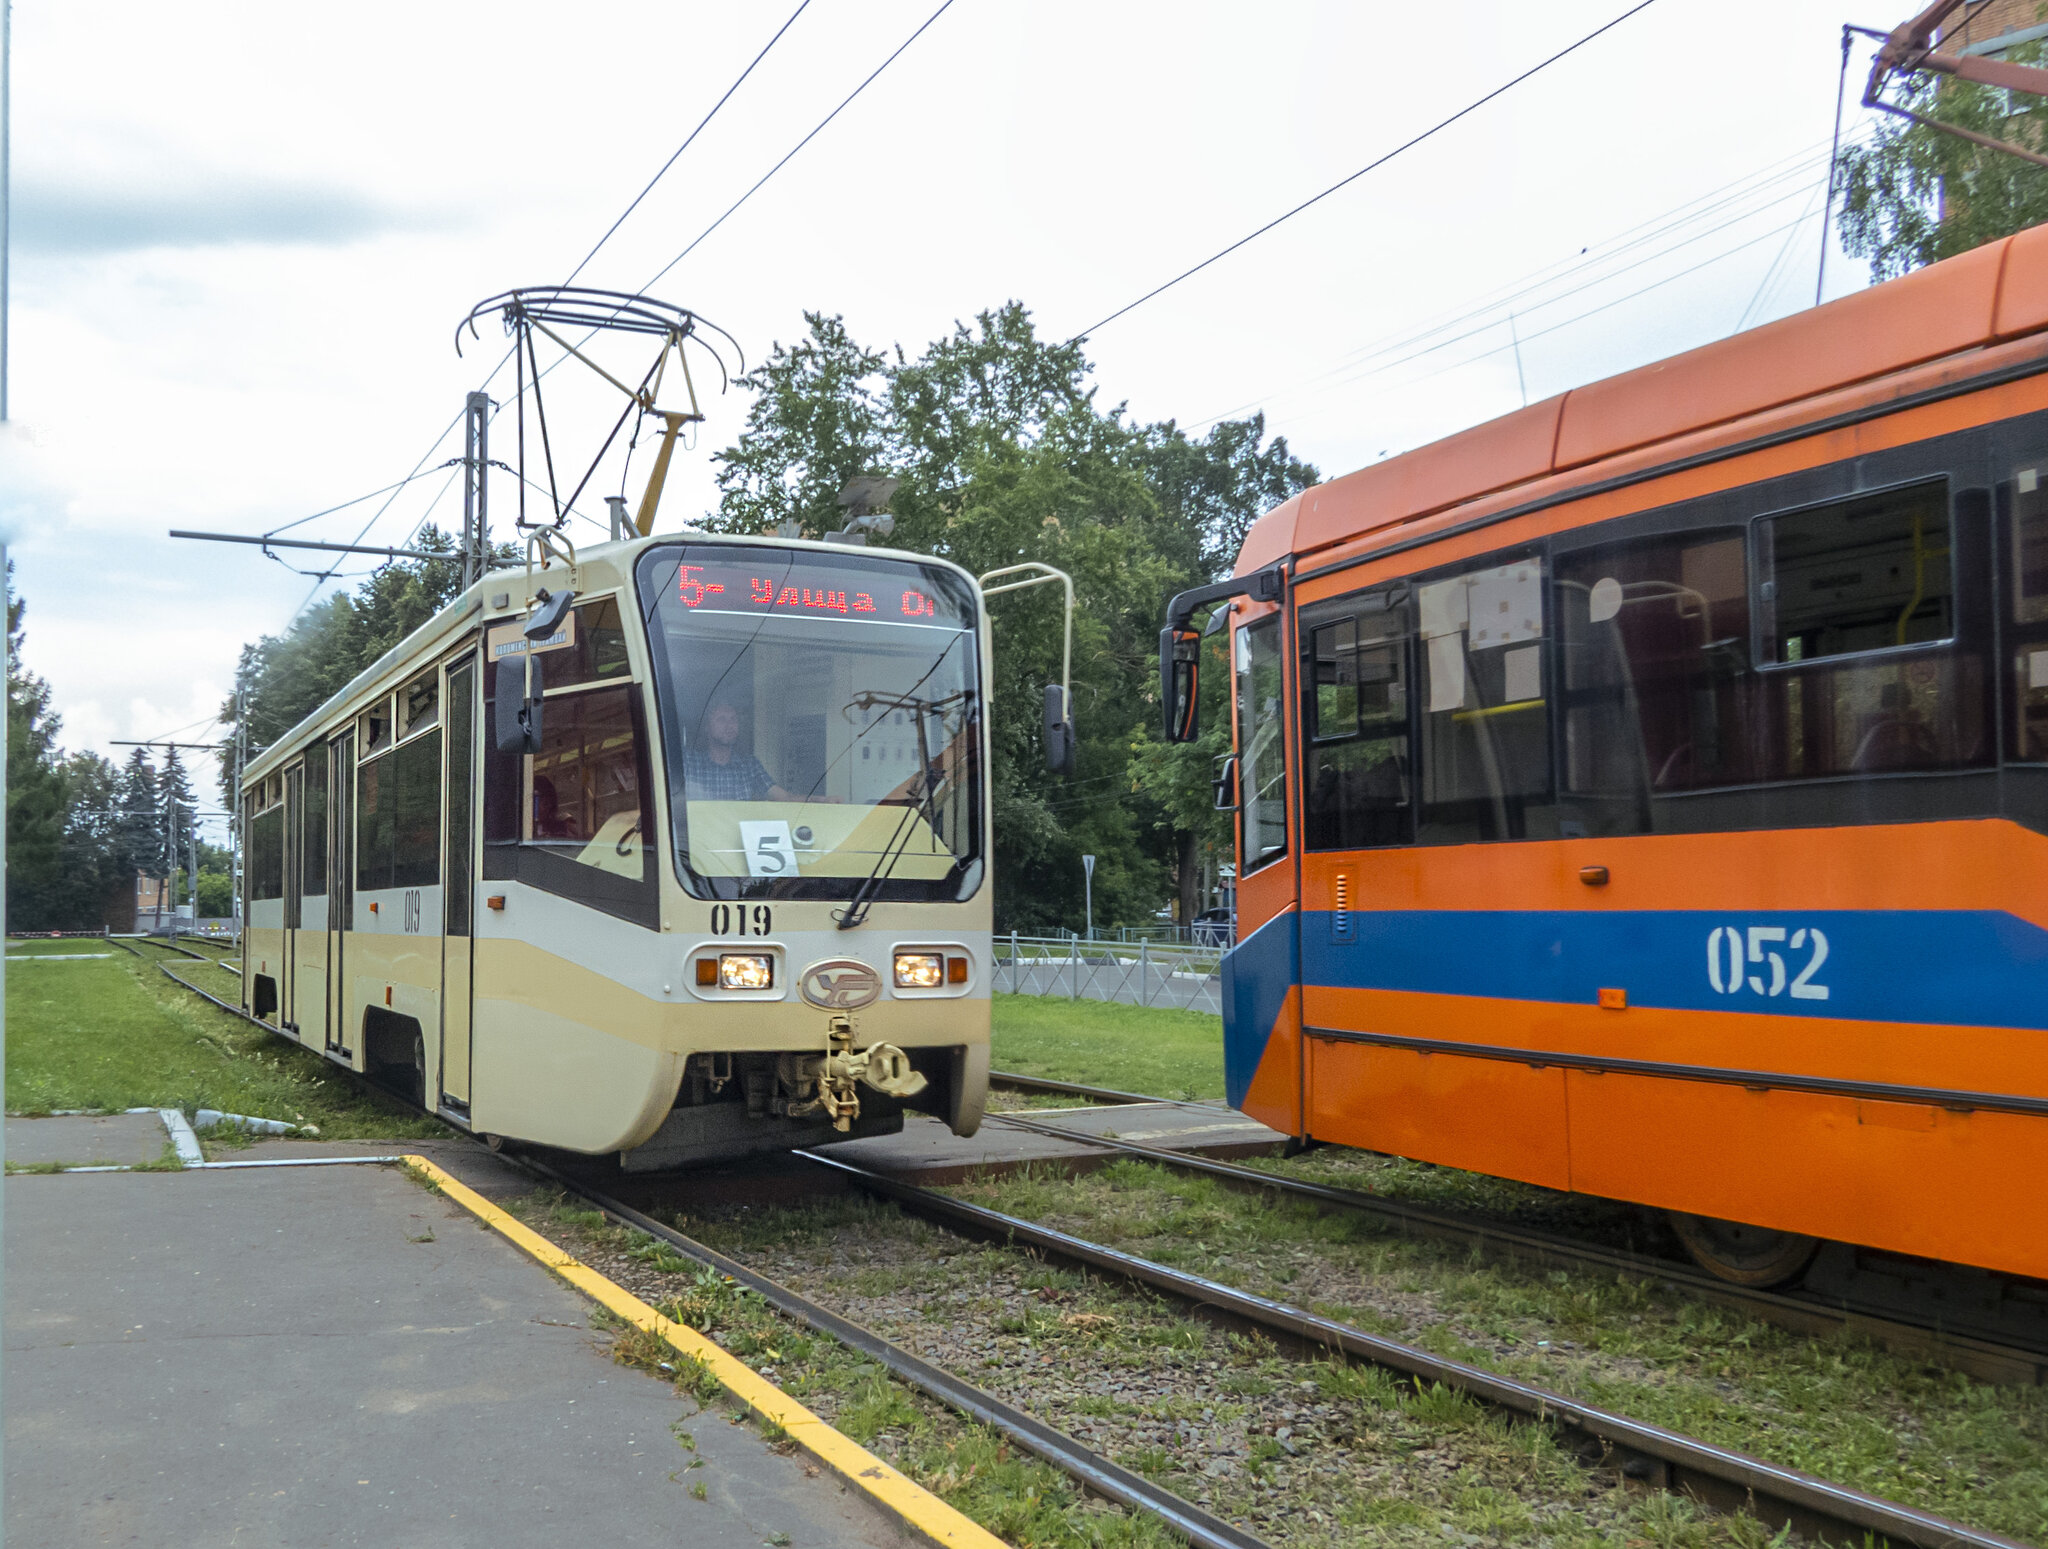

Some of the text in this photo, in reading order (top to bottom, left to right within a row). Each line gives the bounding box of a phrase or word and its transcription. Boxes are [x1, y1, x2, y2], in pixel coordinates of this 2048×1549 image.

[679, 565, 725, 608] 5-
[750, 577, 877, 614] Улица
[757, 836, 786, 873] 5
[404, 889, 421, 933] 019
[710, 904, 772, 936] 019
[1707, 926, 1829, 1000] 052
